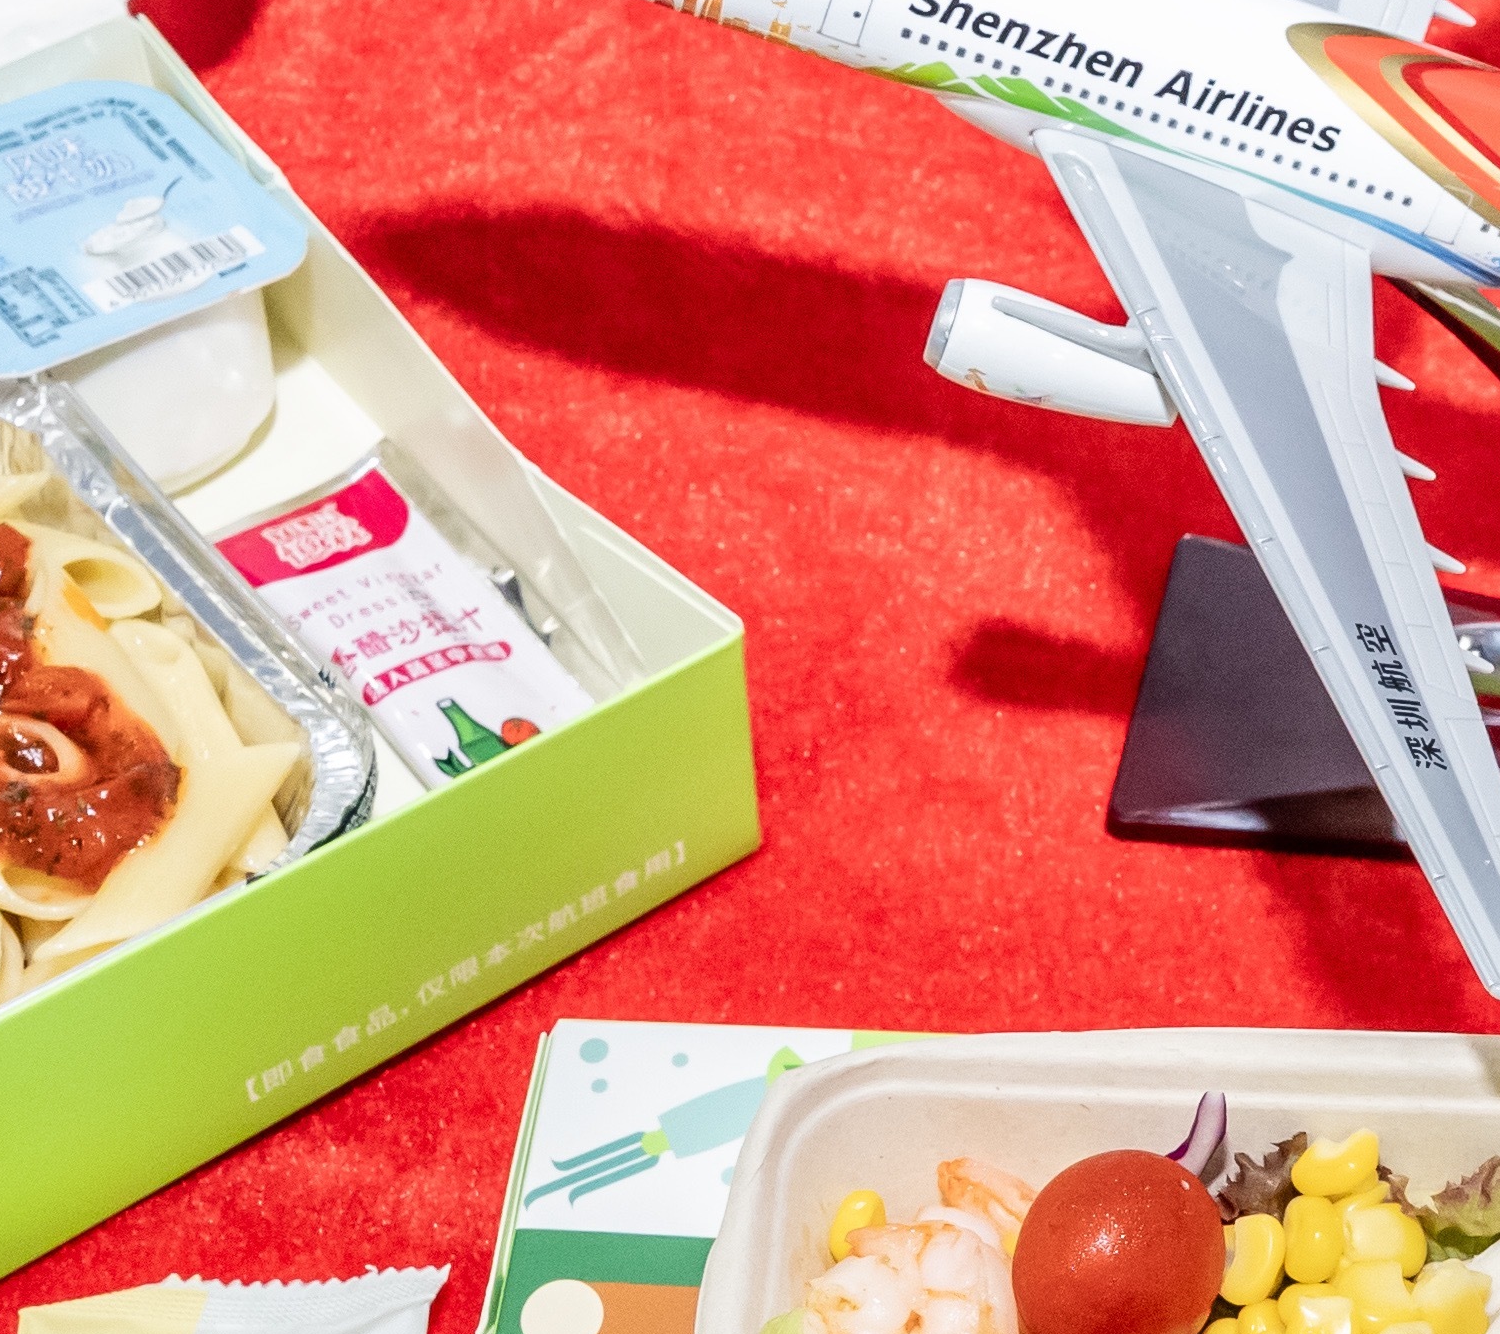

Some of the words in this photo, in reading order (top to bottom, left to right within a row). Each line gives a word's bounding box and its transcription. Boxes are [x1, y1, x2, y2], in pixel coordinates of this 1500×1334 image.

[1154, 69, 1341, 154] Airlines
[1354, 622, 1448, 771] 深圳航空
